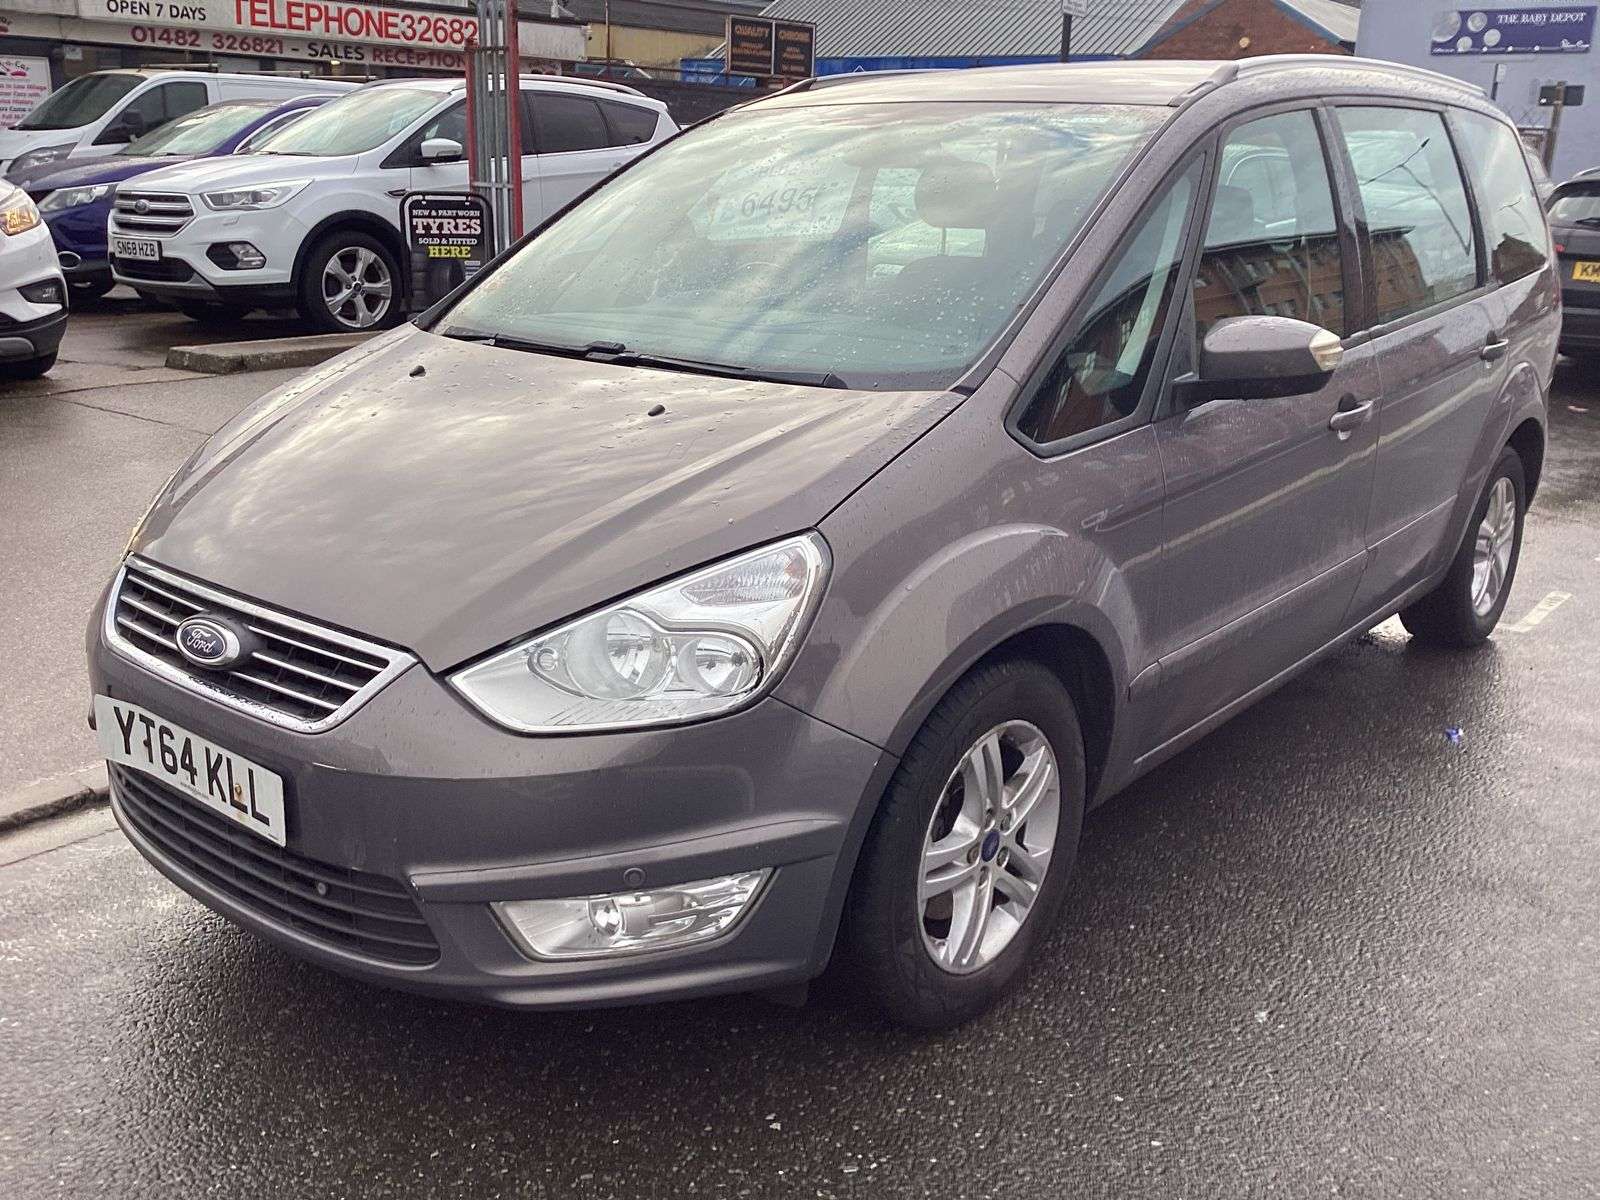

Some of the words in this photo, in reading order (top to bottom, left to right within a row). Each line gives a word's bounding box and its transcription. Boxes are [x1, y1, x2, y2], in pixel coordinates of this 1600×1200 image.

[107, 0, 150, 16] OPEN
[155, 4, 164, 17] 7
[170, 5, 207, 21] DAYS
[1496, 14, 1519, 24] THE
[1520, 14, 1547, 24] BABY
[1550, 12, 1587, 23] DEPOT
[131, 25, 200, 47] 01482
[212, 33, 284, 54] 326821
[308, 42, 364, 61] SALES
[412, 218, 482, 235] TYRES
[117, 240, 138, 256] SN68
[138, 242, 156, 257] HZB
[418, 237, 440, 245] SOLD
[448, 237, 478, 245] FITTED
[428, 245, 471, 258] HERE
[187, 628, 216, 653] Ford
[114, 706, 198, 787] YT64
[205, 746, 270, 827] KLL
